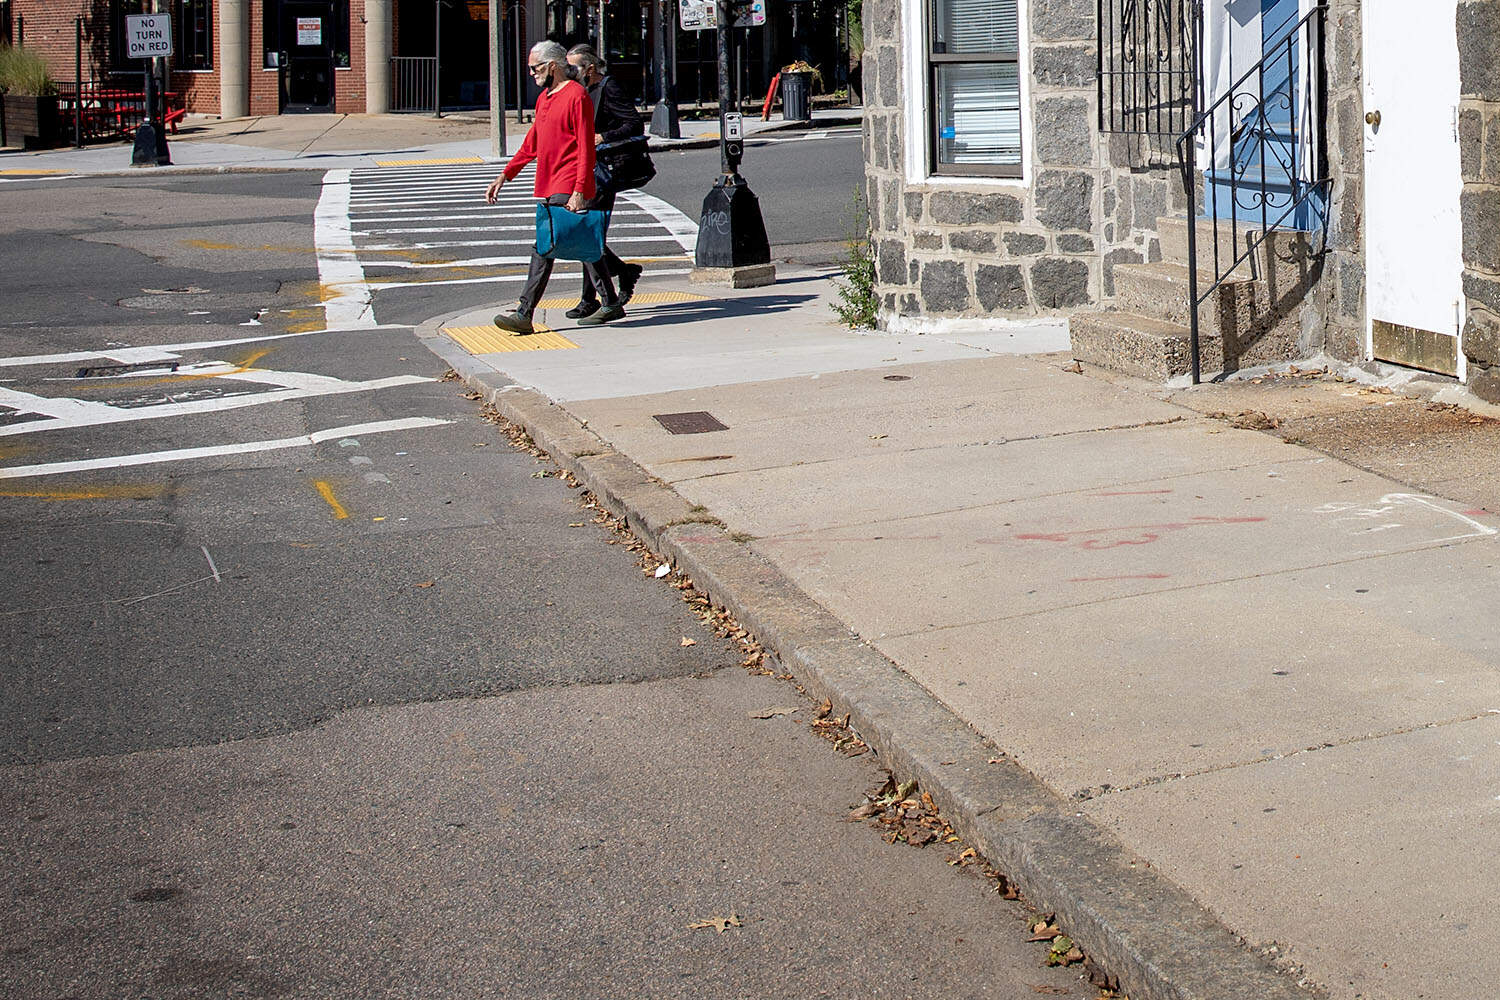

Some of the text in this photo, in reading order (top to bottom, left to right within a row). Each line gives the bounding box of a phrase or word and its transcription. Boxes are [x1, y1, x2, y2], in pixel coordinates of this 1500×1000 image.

[141, 19, 155, 28] NO
[136, 30, 162, 40] TURN
[131, 41, 168, 52] ON RED
